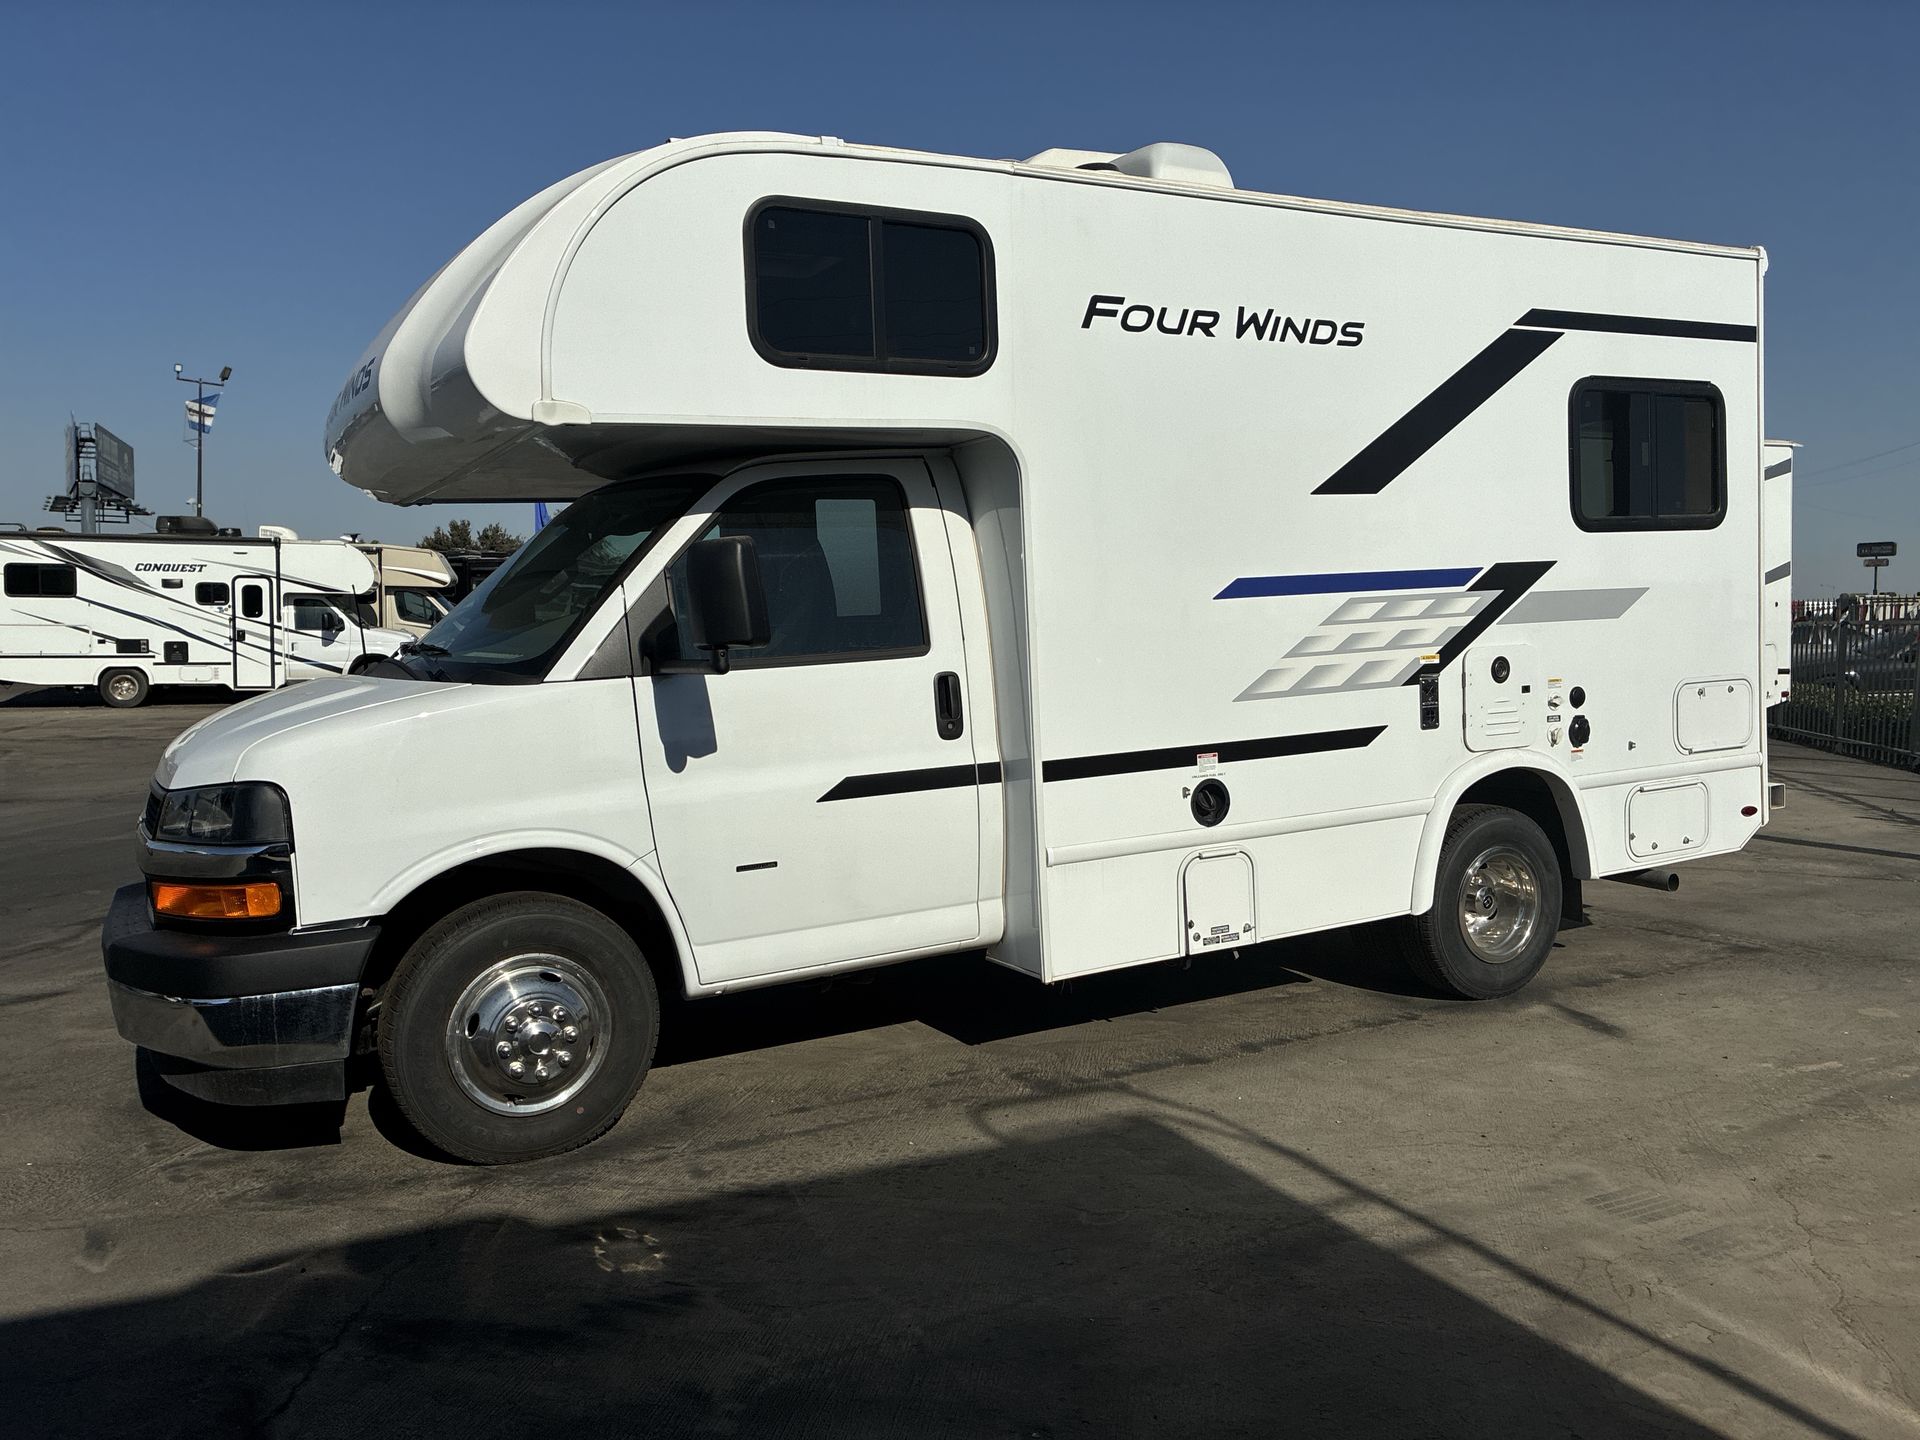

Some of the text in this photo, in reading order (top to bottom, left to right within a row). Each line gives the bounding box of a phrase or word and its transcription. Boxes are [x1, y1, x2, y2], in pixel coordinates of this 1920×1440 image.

[1080, 294, 1366, 347] FOUR WINDS
[339, 355, 377, 410] NDS
[134, 562, 208, 573] CONQUEST
